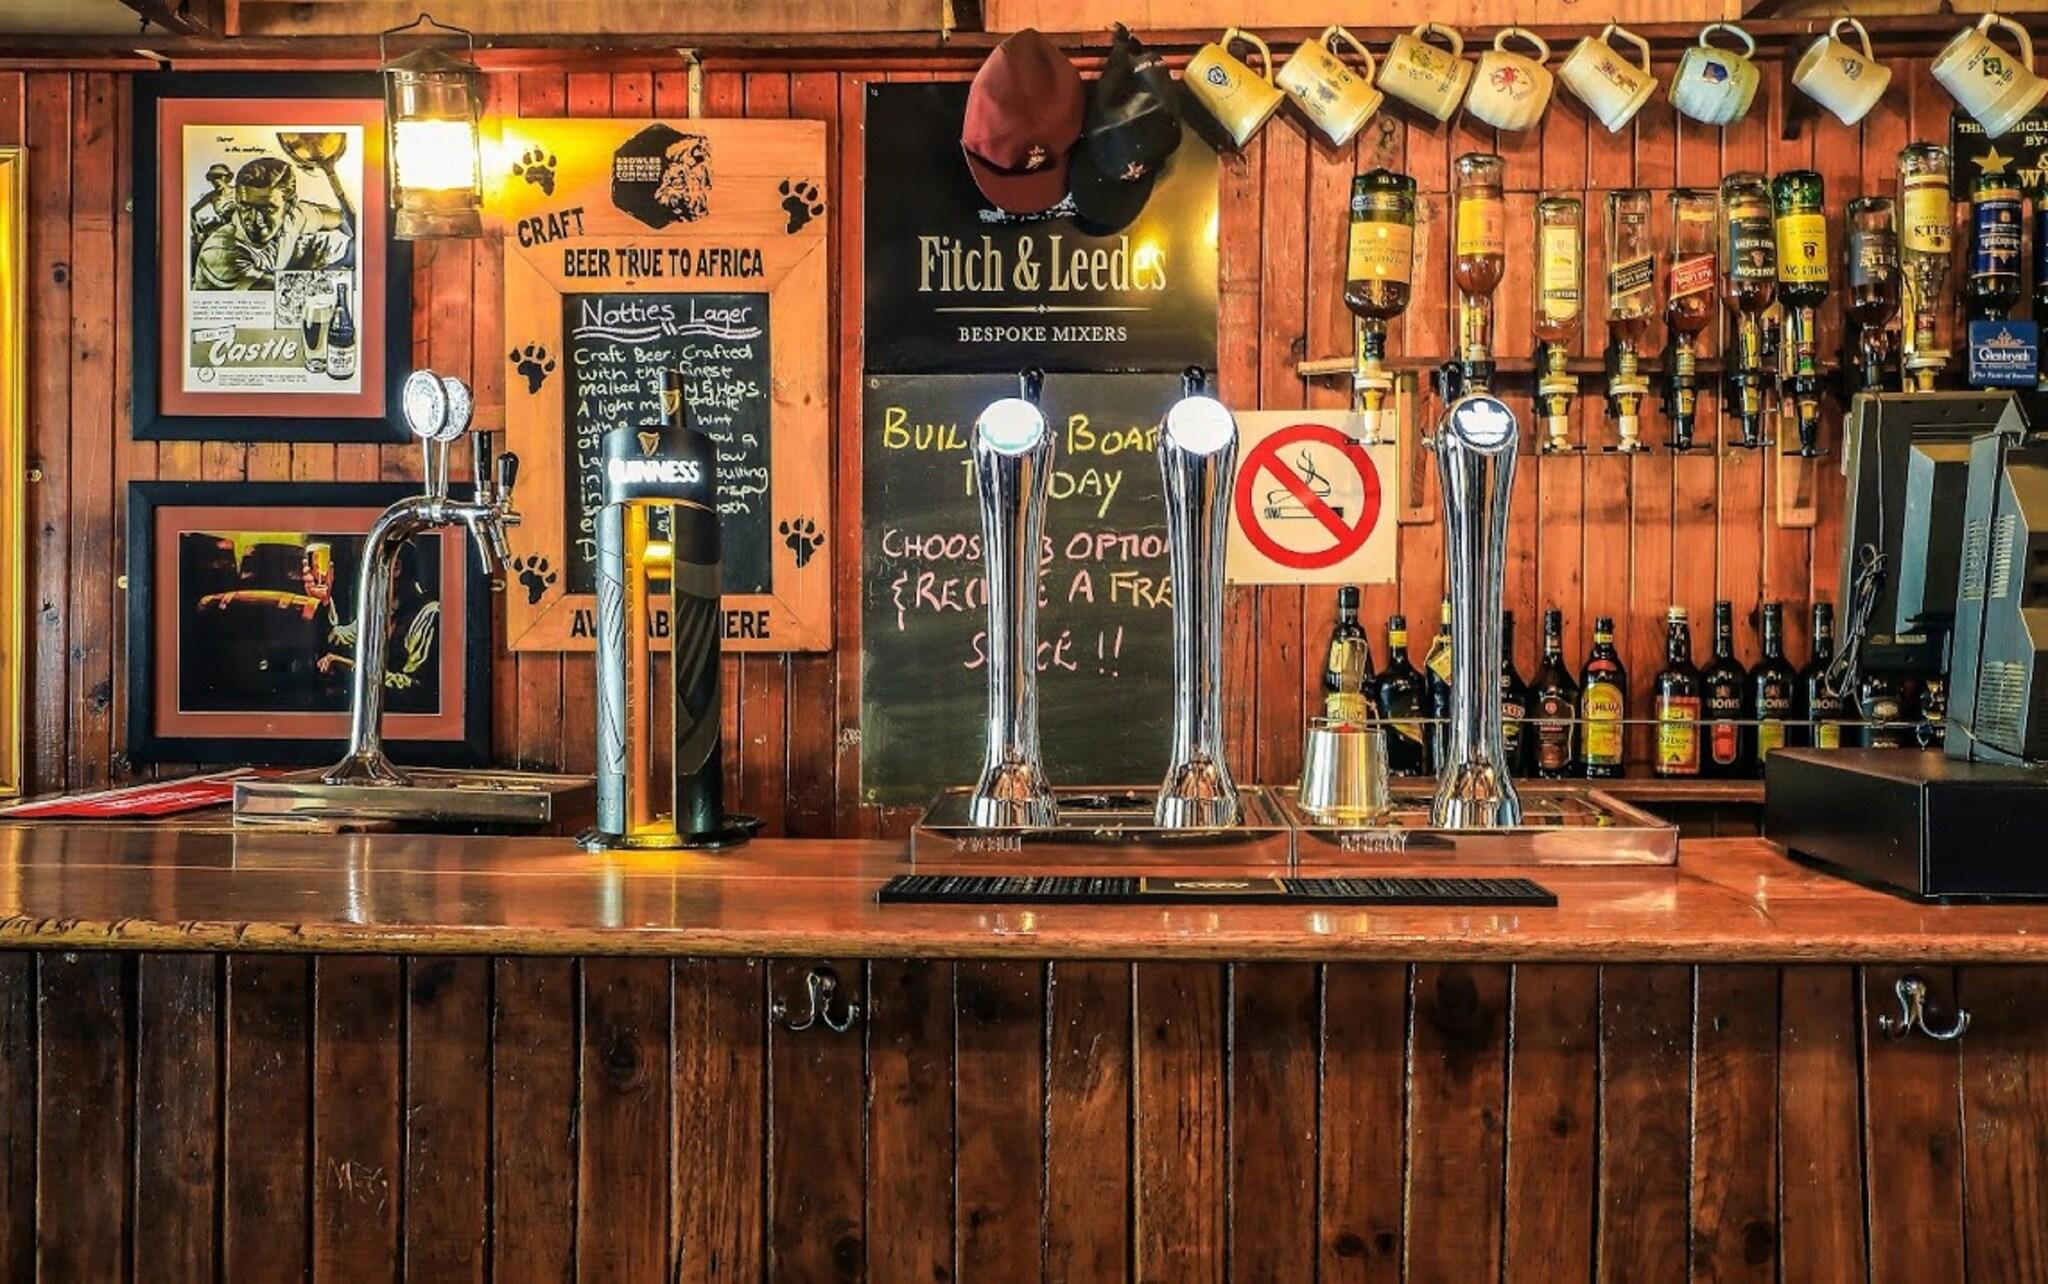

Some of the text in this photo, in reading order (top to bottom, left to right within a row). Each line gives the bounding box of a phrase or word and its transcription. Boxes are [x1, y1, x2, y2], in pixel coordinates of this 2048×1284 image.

[517, 207, 584, 248] CRAFT
[564, 249, 764, 277] BEER TRUE TO AFRICA
[918, 235, 1167, 292] Fitch & Leedes
[582, 298, 753, 333] Notties Lager
[958, 326, 1128, 342] BESPOKE MIXERS
[209, 336, 299, 366] Castle
[574, 344, 627, 365] Craft
[576, 400, 590, 419] A
[883, 406, 968, 451] BUIL
[608, 458, 700, 485] GUINNESS
[882, 528, 981, 561] CHOOS
[1065, 532, 1170, 562] OPTIO
[1068, 569, 1095, 603] A
[1110, 571, 1174, 609] FRE
[721, 609, 770, 638] ERE
